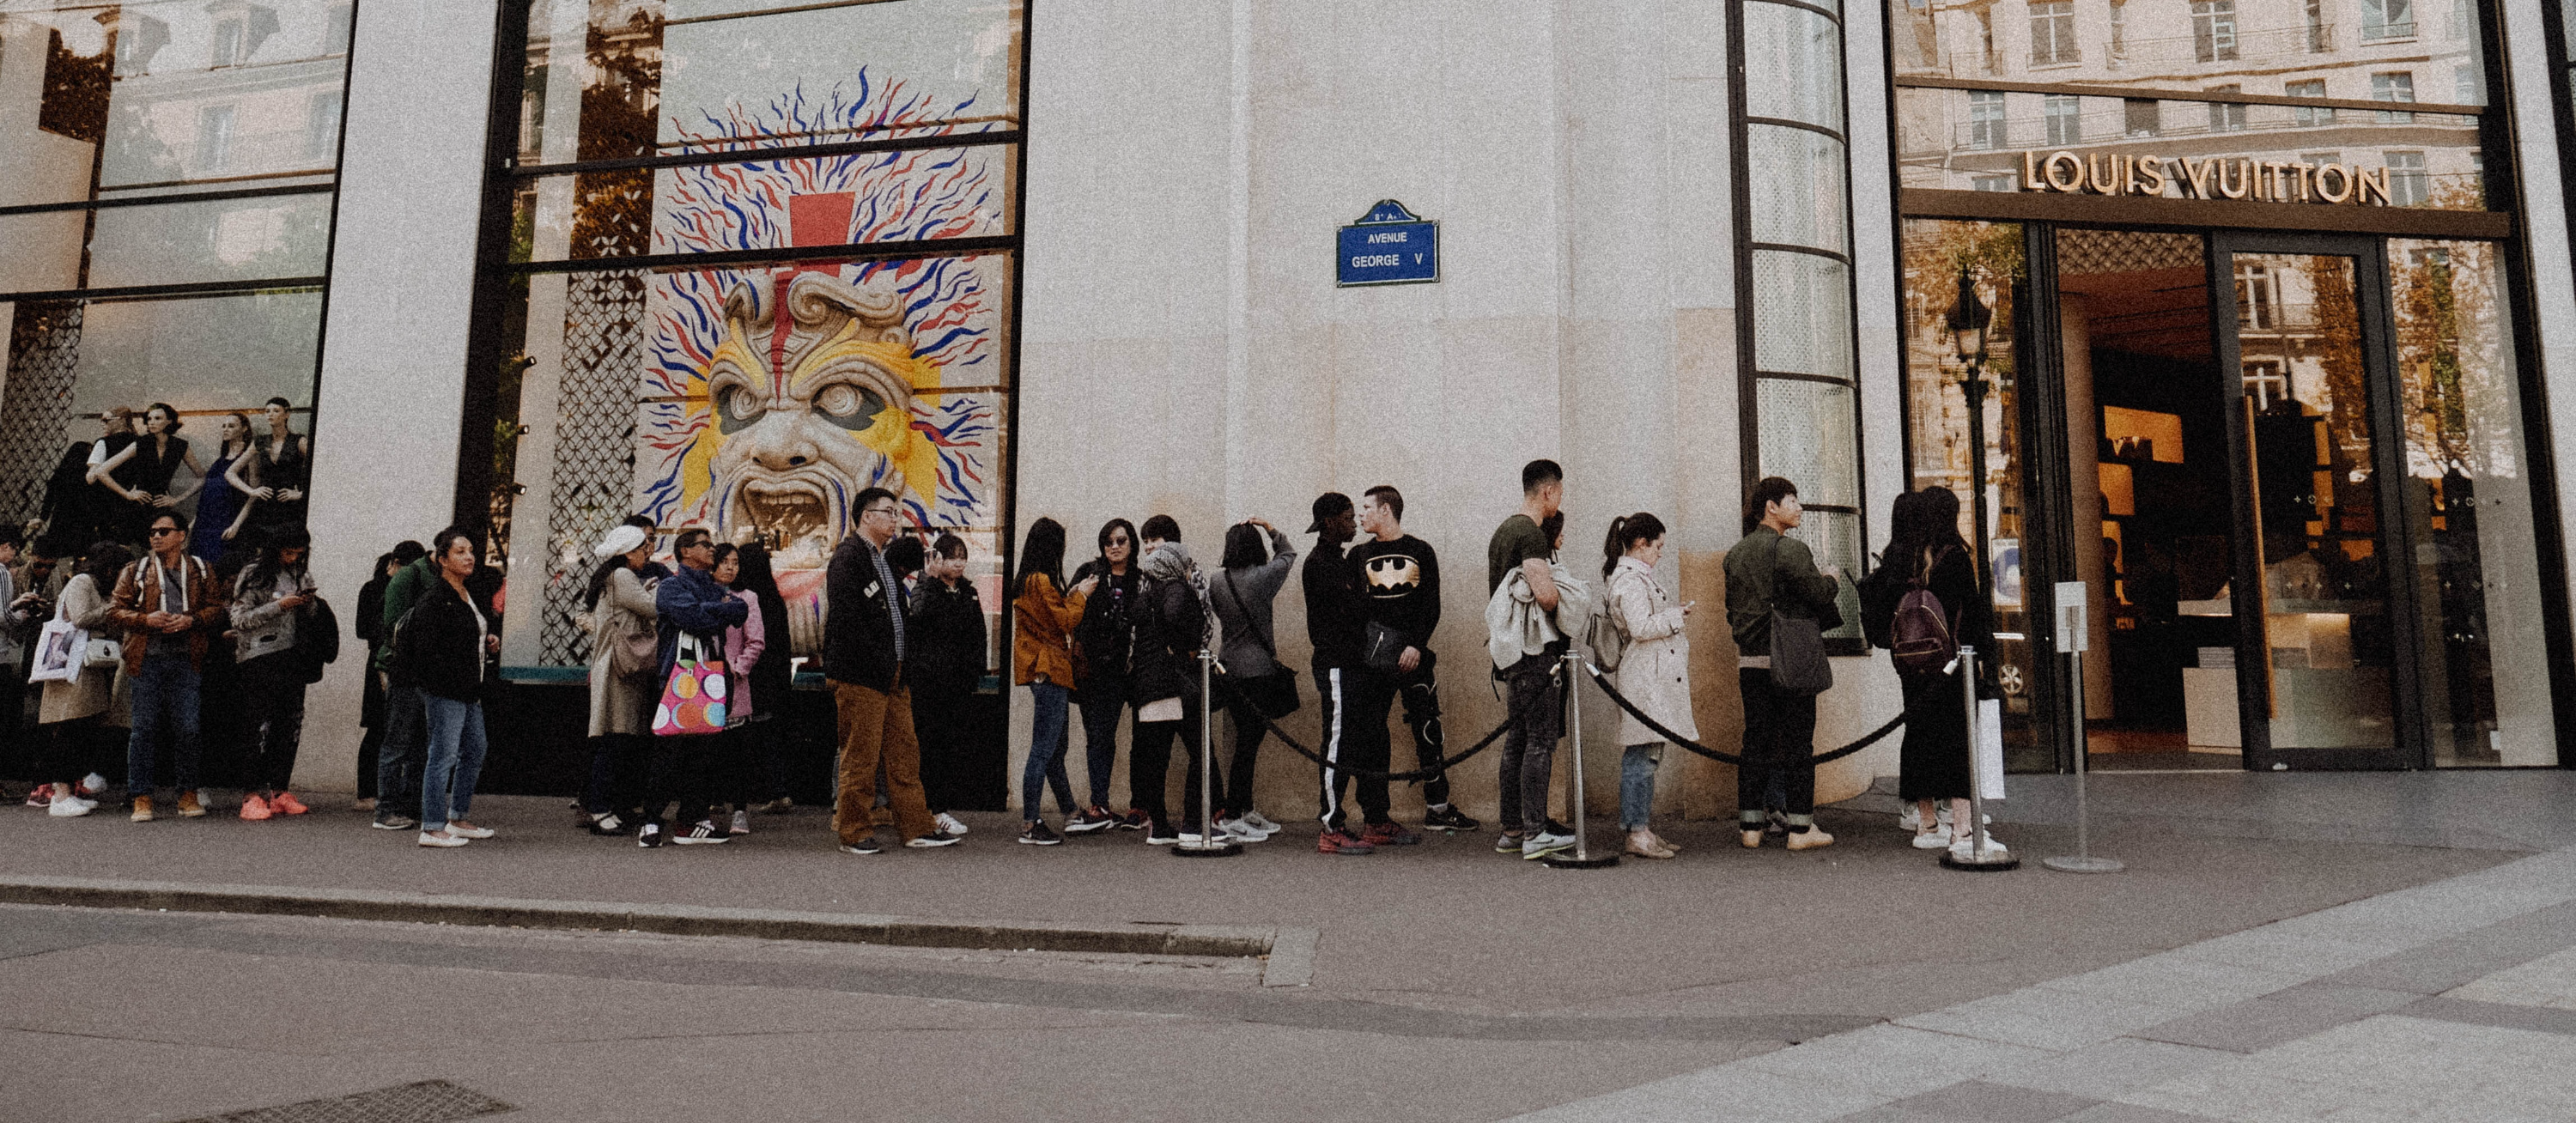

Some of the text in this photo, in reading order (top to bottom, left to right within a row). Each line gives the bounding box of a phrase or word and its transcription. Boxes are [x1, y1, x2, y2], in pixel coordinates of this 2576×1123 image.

[2025, 150, 2392, 205] LOUIS VUITTON
[1368, 232, 1407, 244] AVENUE
[1352, 252, 1423, 268] GEORGE V
